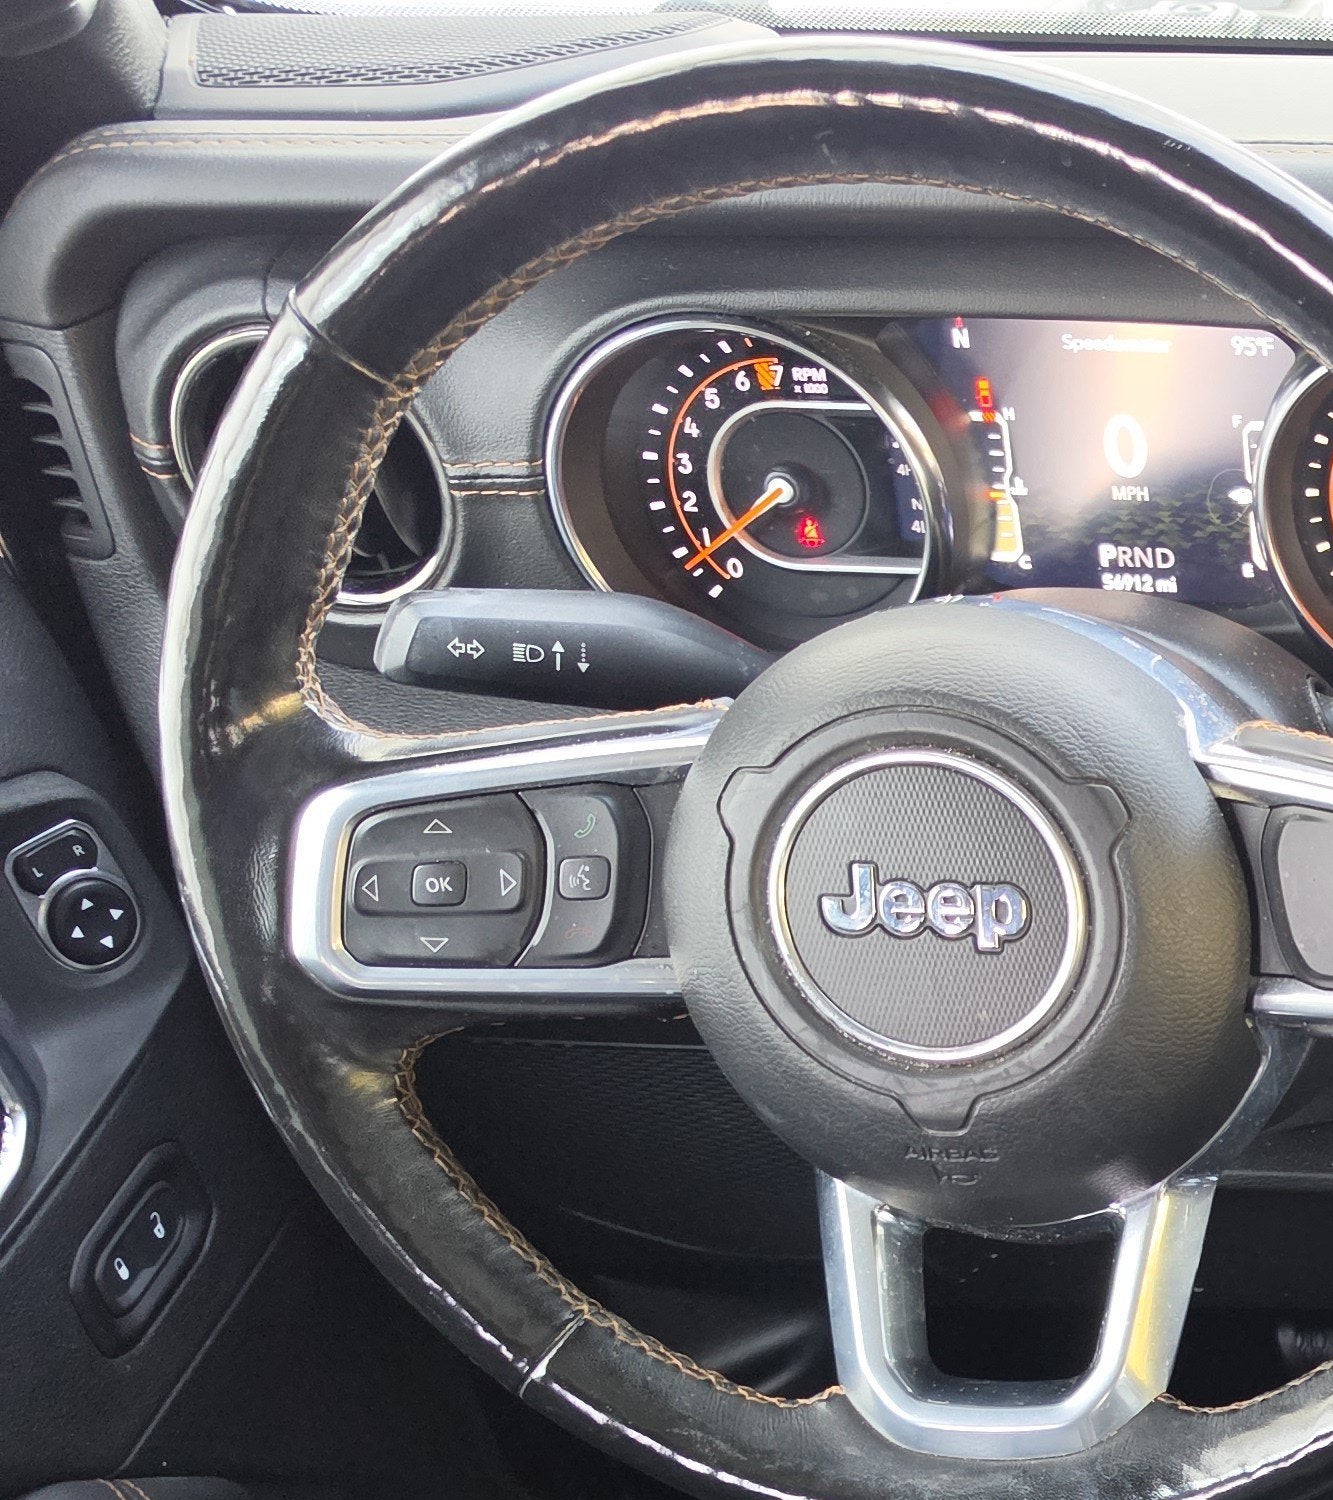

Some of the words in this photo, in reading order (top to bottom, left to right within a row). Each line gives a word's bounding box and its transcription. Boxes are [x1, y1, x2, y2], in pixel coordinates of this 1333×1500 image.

[952, 328, 971, 349] N
[735, 370, 751, 392] 6
[768, 364, 784, 387] 7
[791, 366, 828, 381] RPM
[704, 387, 720, 409] 5
[803, 382, 829, 394] 1000
[684, 417, 700, 438] 4
[1103, 414, 1149, 479] 0
[675, 452, 693, 475] 3
[682, 490, 699, 513] 2
[1111, 486, 1151, 502] MPH
[726, 557, 744, 579] 0
[1242, 562, 1255, 578] E
[1101, 572, 1153, 593] 56912
[1155, 576, 1178, 593] mi
[424, 875, 453, 894] OK
[821, 860, 1029, 951] Jeep
